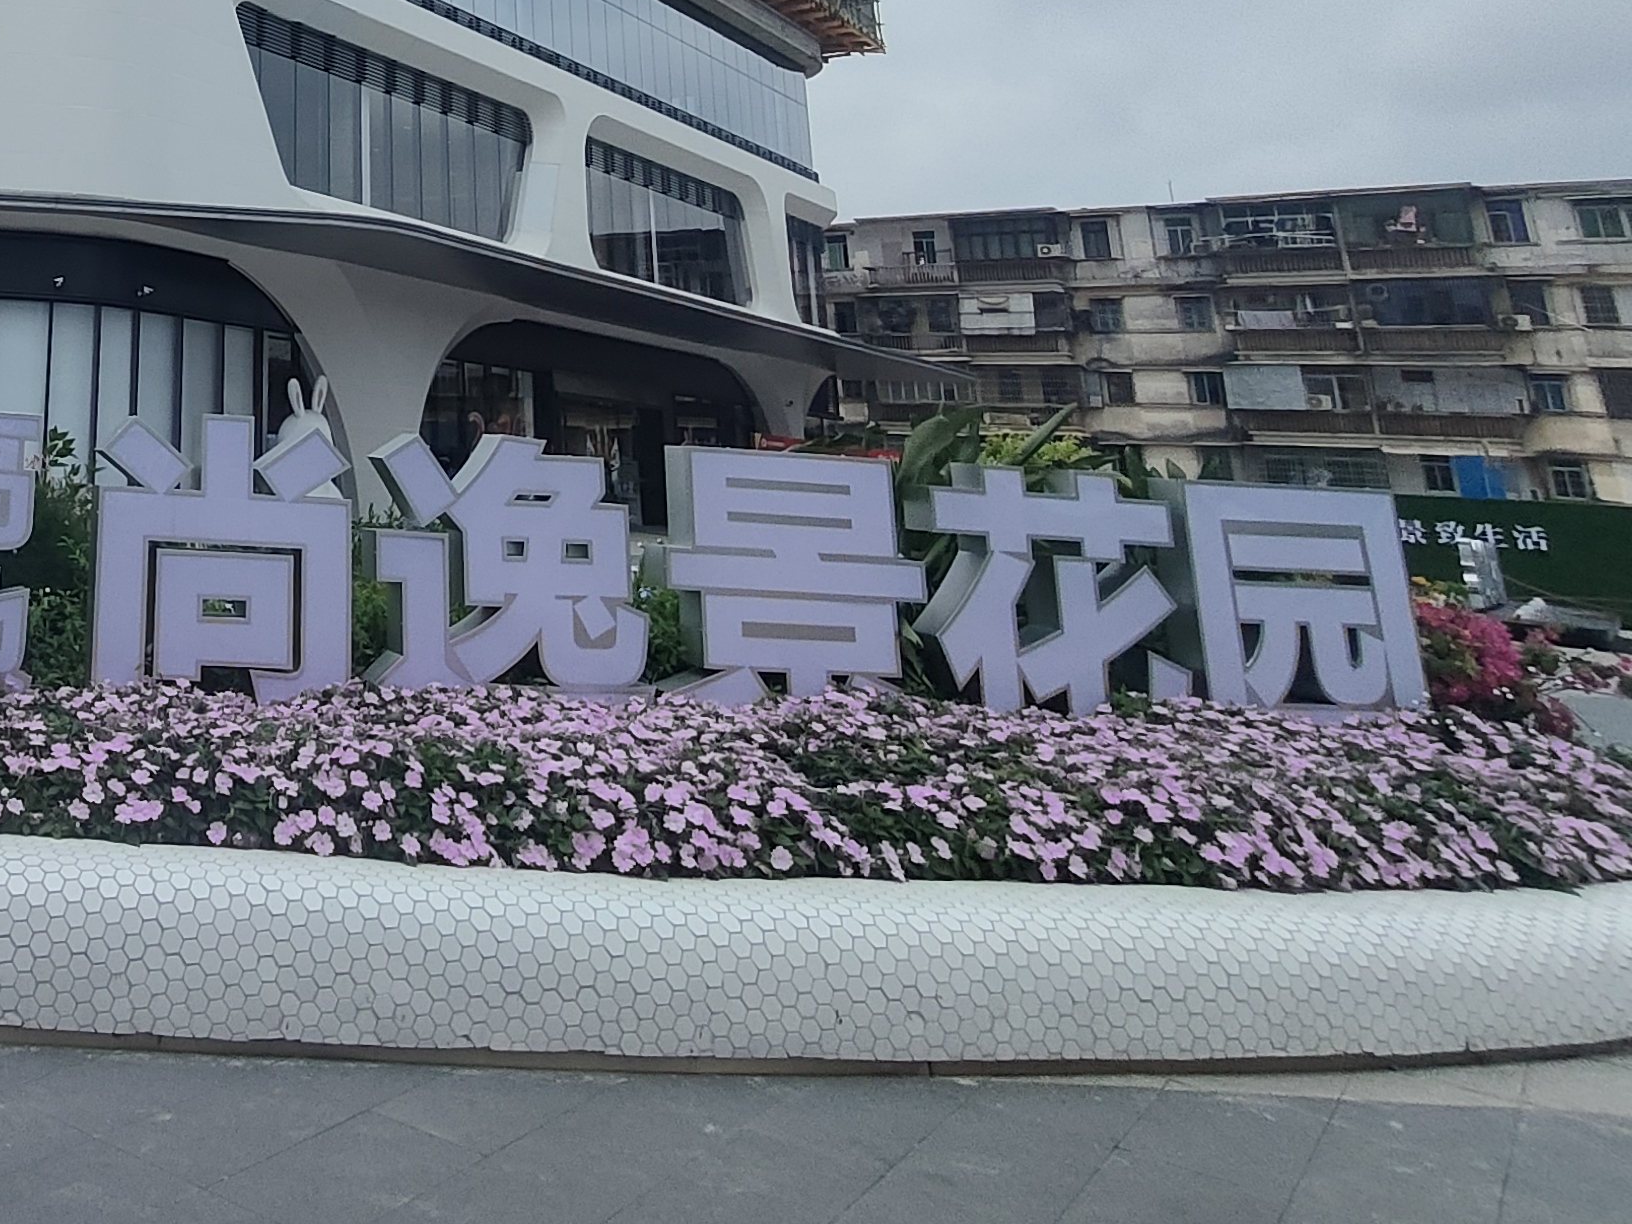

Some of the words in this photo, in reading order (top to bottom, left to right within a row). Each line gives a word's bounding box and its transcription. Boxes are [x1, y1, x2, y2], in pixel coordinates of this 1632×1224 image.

[94, 414, 1428, 713] 尚逸景花园
